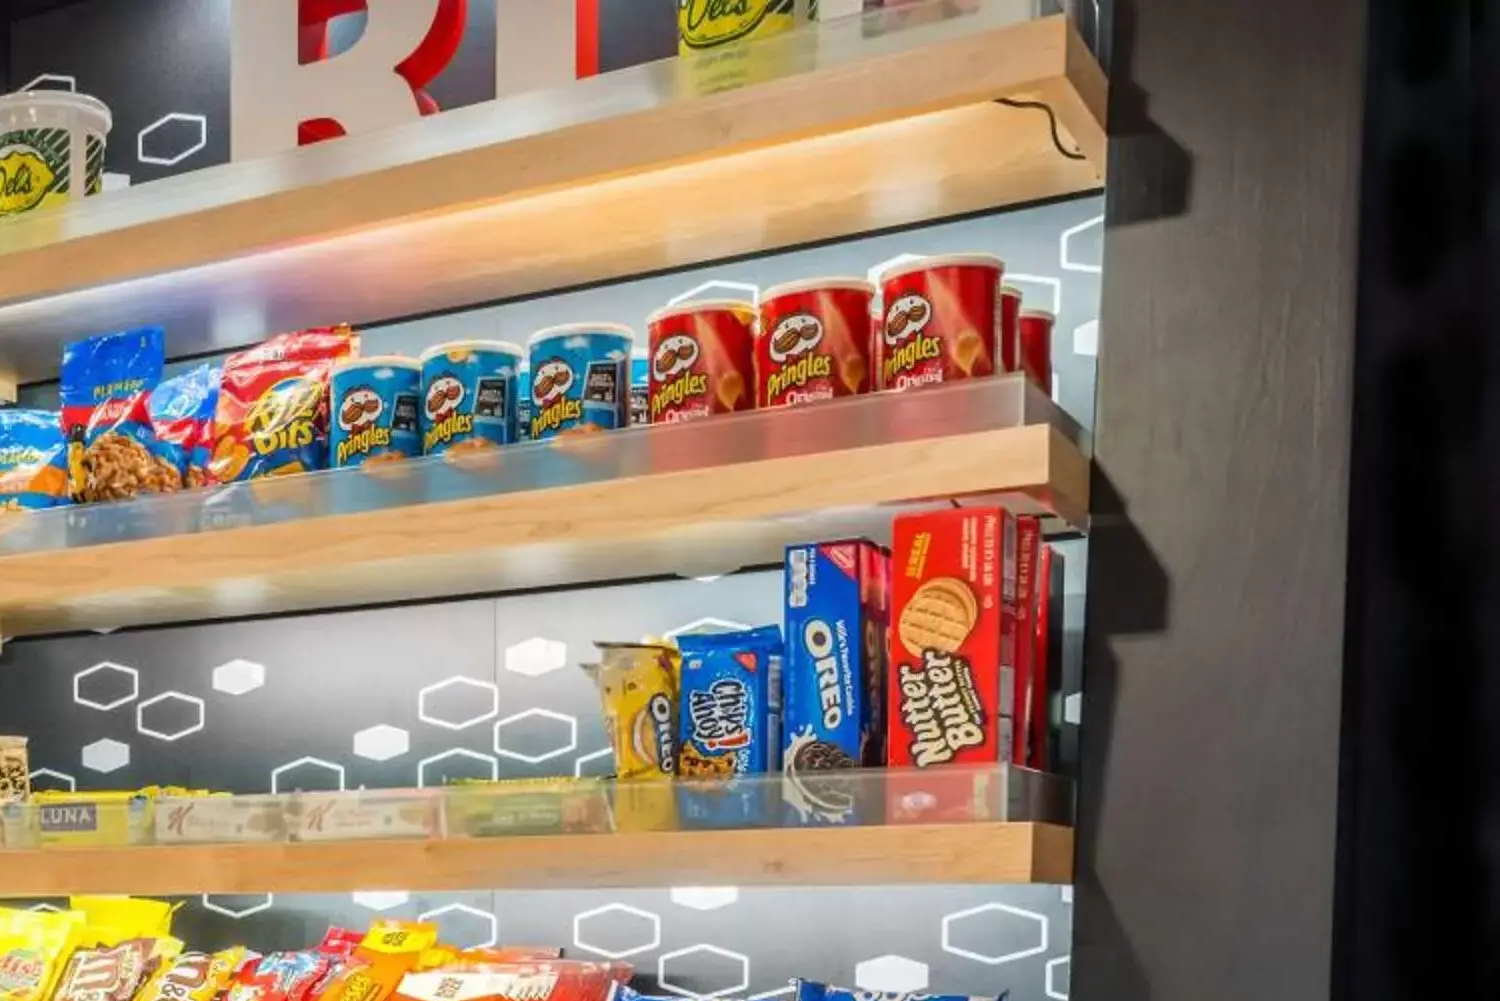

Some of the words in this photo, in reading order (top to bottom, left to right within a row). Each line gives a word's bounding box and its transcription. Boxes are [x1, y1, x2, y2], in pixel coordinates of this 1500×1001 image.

[767, 352, 831, 405] Pringles
[884, 334, 941, 382] Pringles
[531, 396, 581, 440] Pringles
[651, 371, 707, 424] Pringles
[337, 424, 390, 467] Pringles
[805, 619, 841, 729] OREO
[924, 650, 984, 750] Butter
[651, 693, 675, 770] OREO
[711, 680, 747, 734] Chips
[899, 665, 953, 768] Nutter
[39, 803, 94, 825] LUNA
